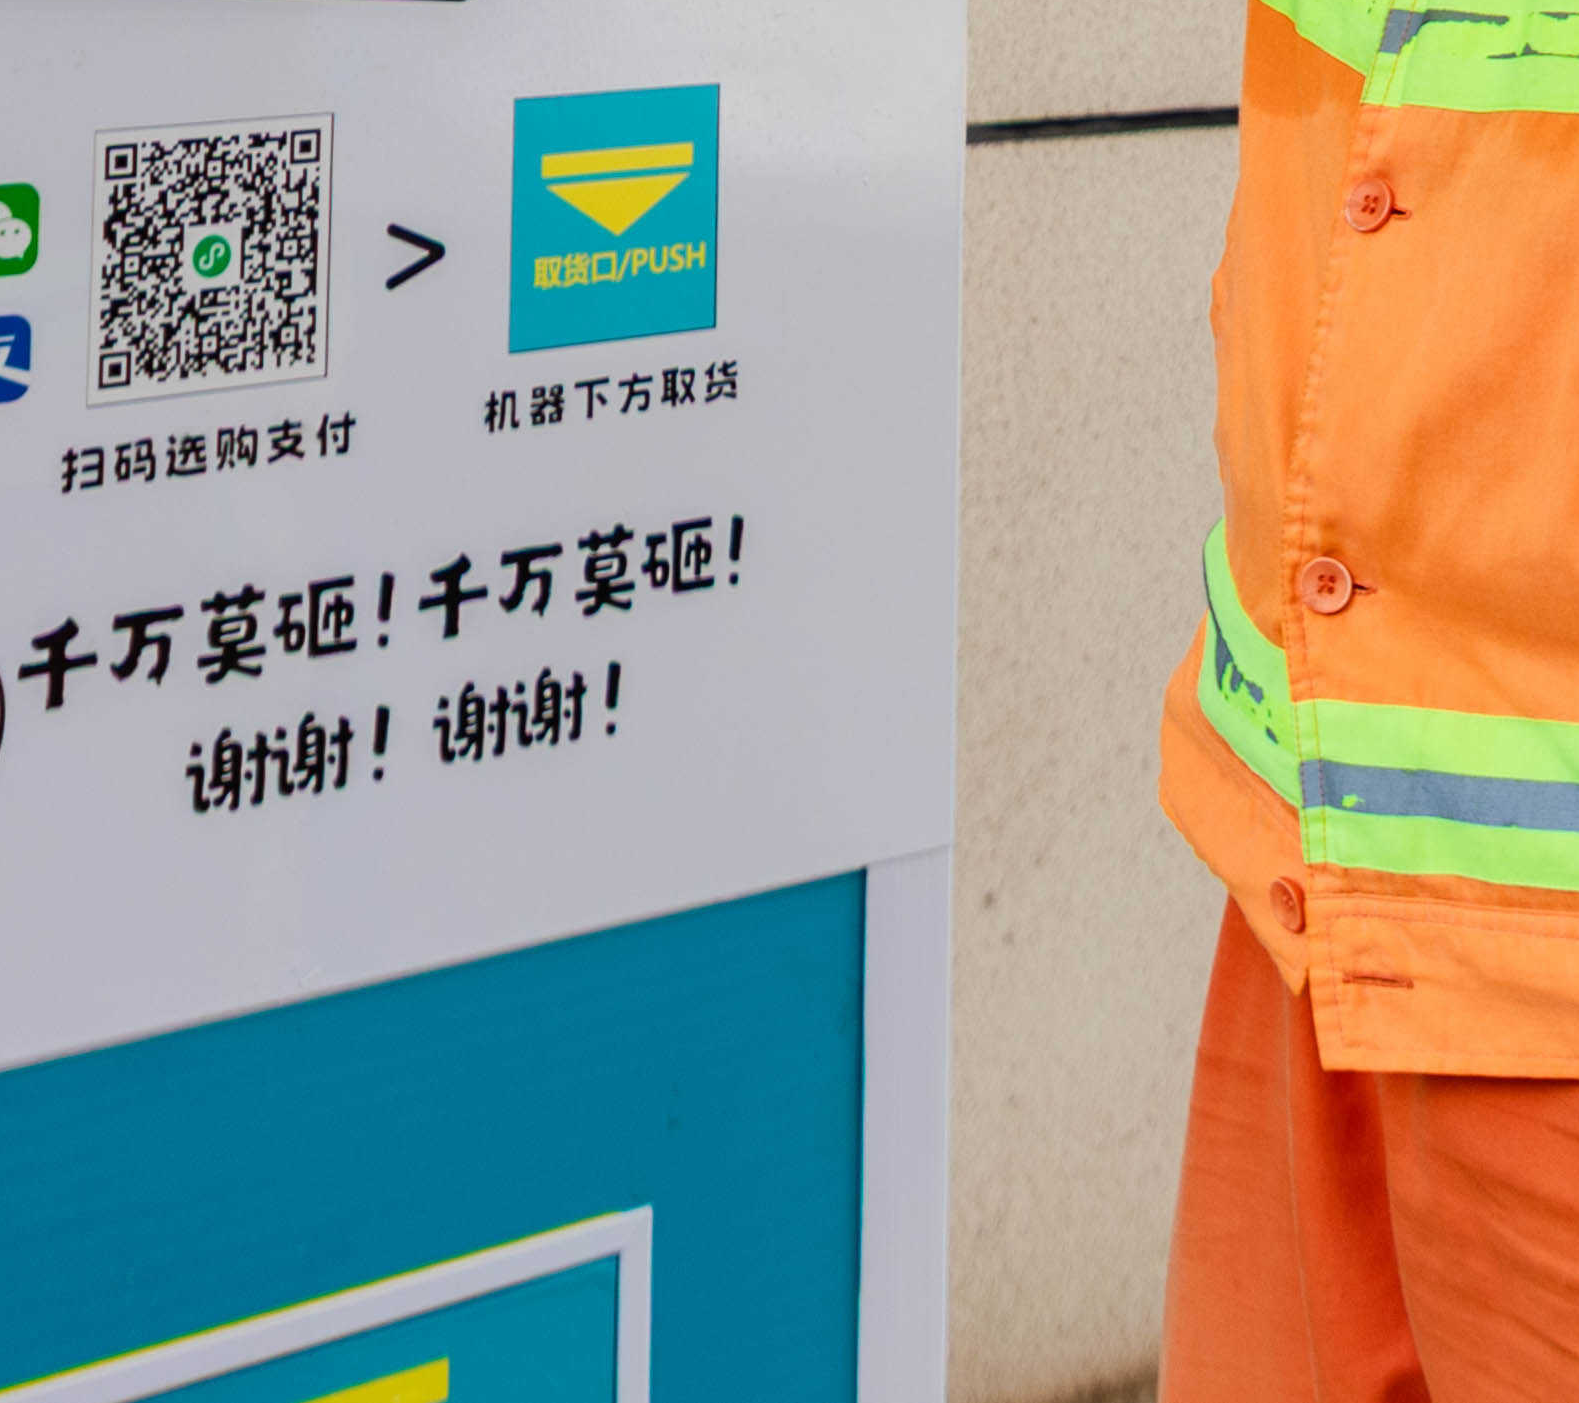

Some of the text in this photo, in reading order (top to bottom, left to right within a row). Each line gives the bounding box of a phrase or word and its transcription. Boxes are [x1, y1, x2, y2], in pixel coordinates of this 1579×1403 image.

[483, 360, 741, 434] 机器下方取货
[60, 411, 357, 494] 扫码选购支付
